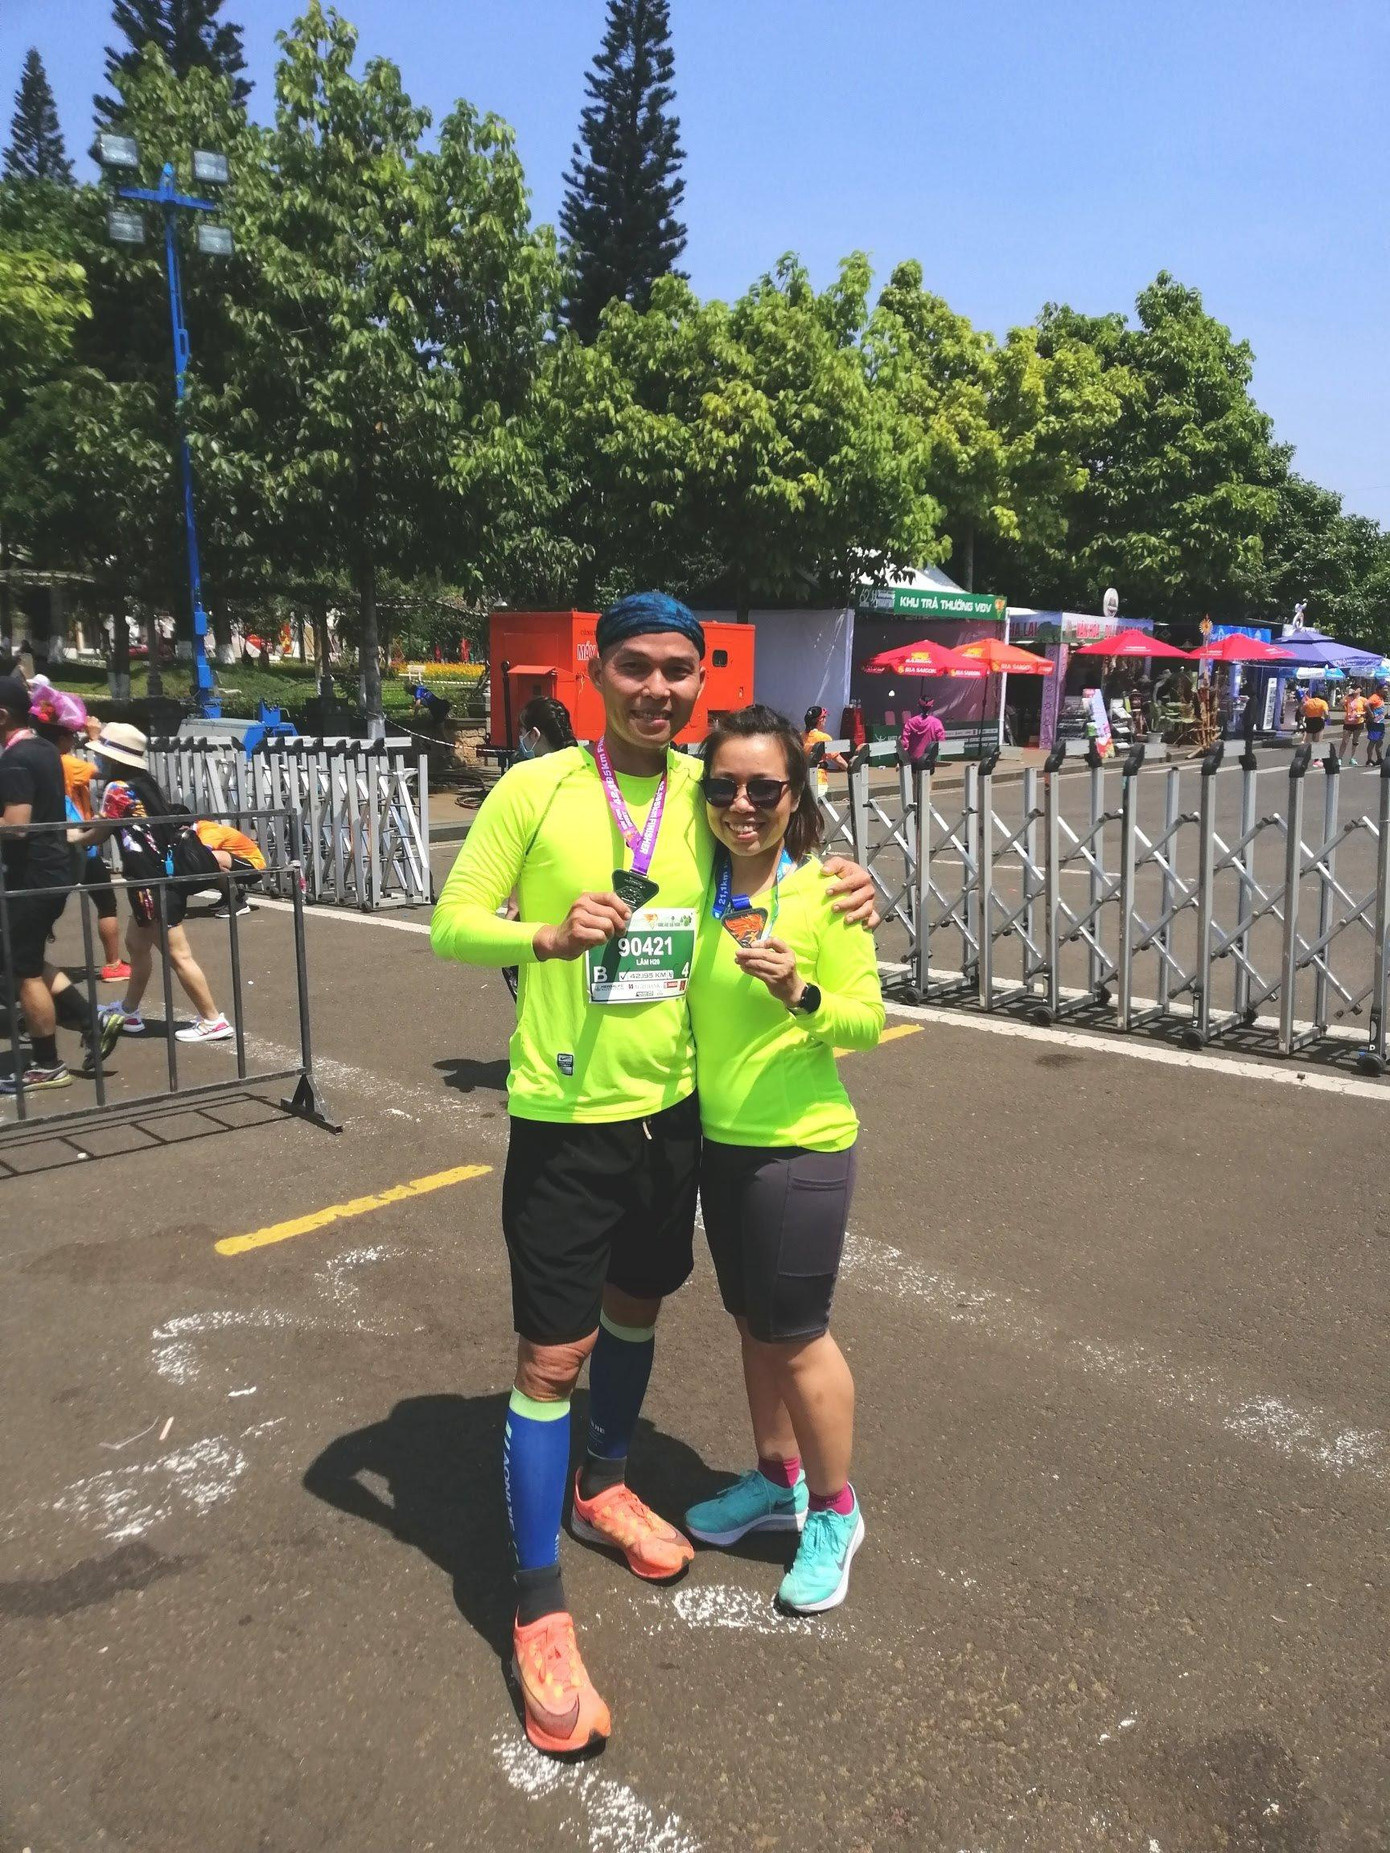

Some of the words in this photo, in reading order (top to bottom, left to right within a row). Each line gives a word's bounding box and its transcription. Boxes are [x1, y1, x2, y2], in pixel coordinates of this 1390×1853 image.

[900, 596, 919, 608] KHU
[639, 817, 657, 855] FINISHER
[718, 871, 729, 906] 21,1km
[618, 936, 672, 957] 90421
[593, 966, 608, 984] B
[682, 961, 690, 978] 4
